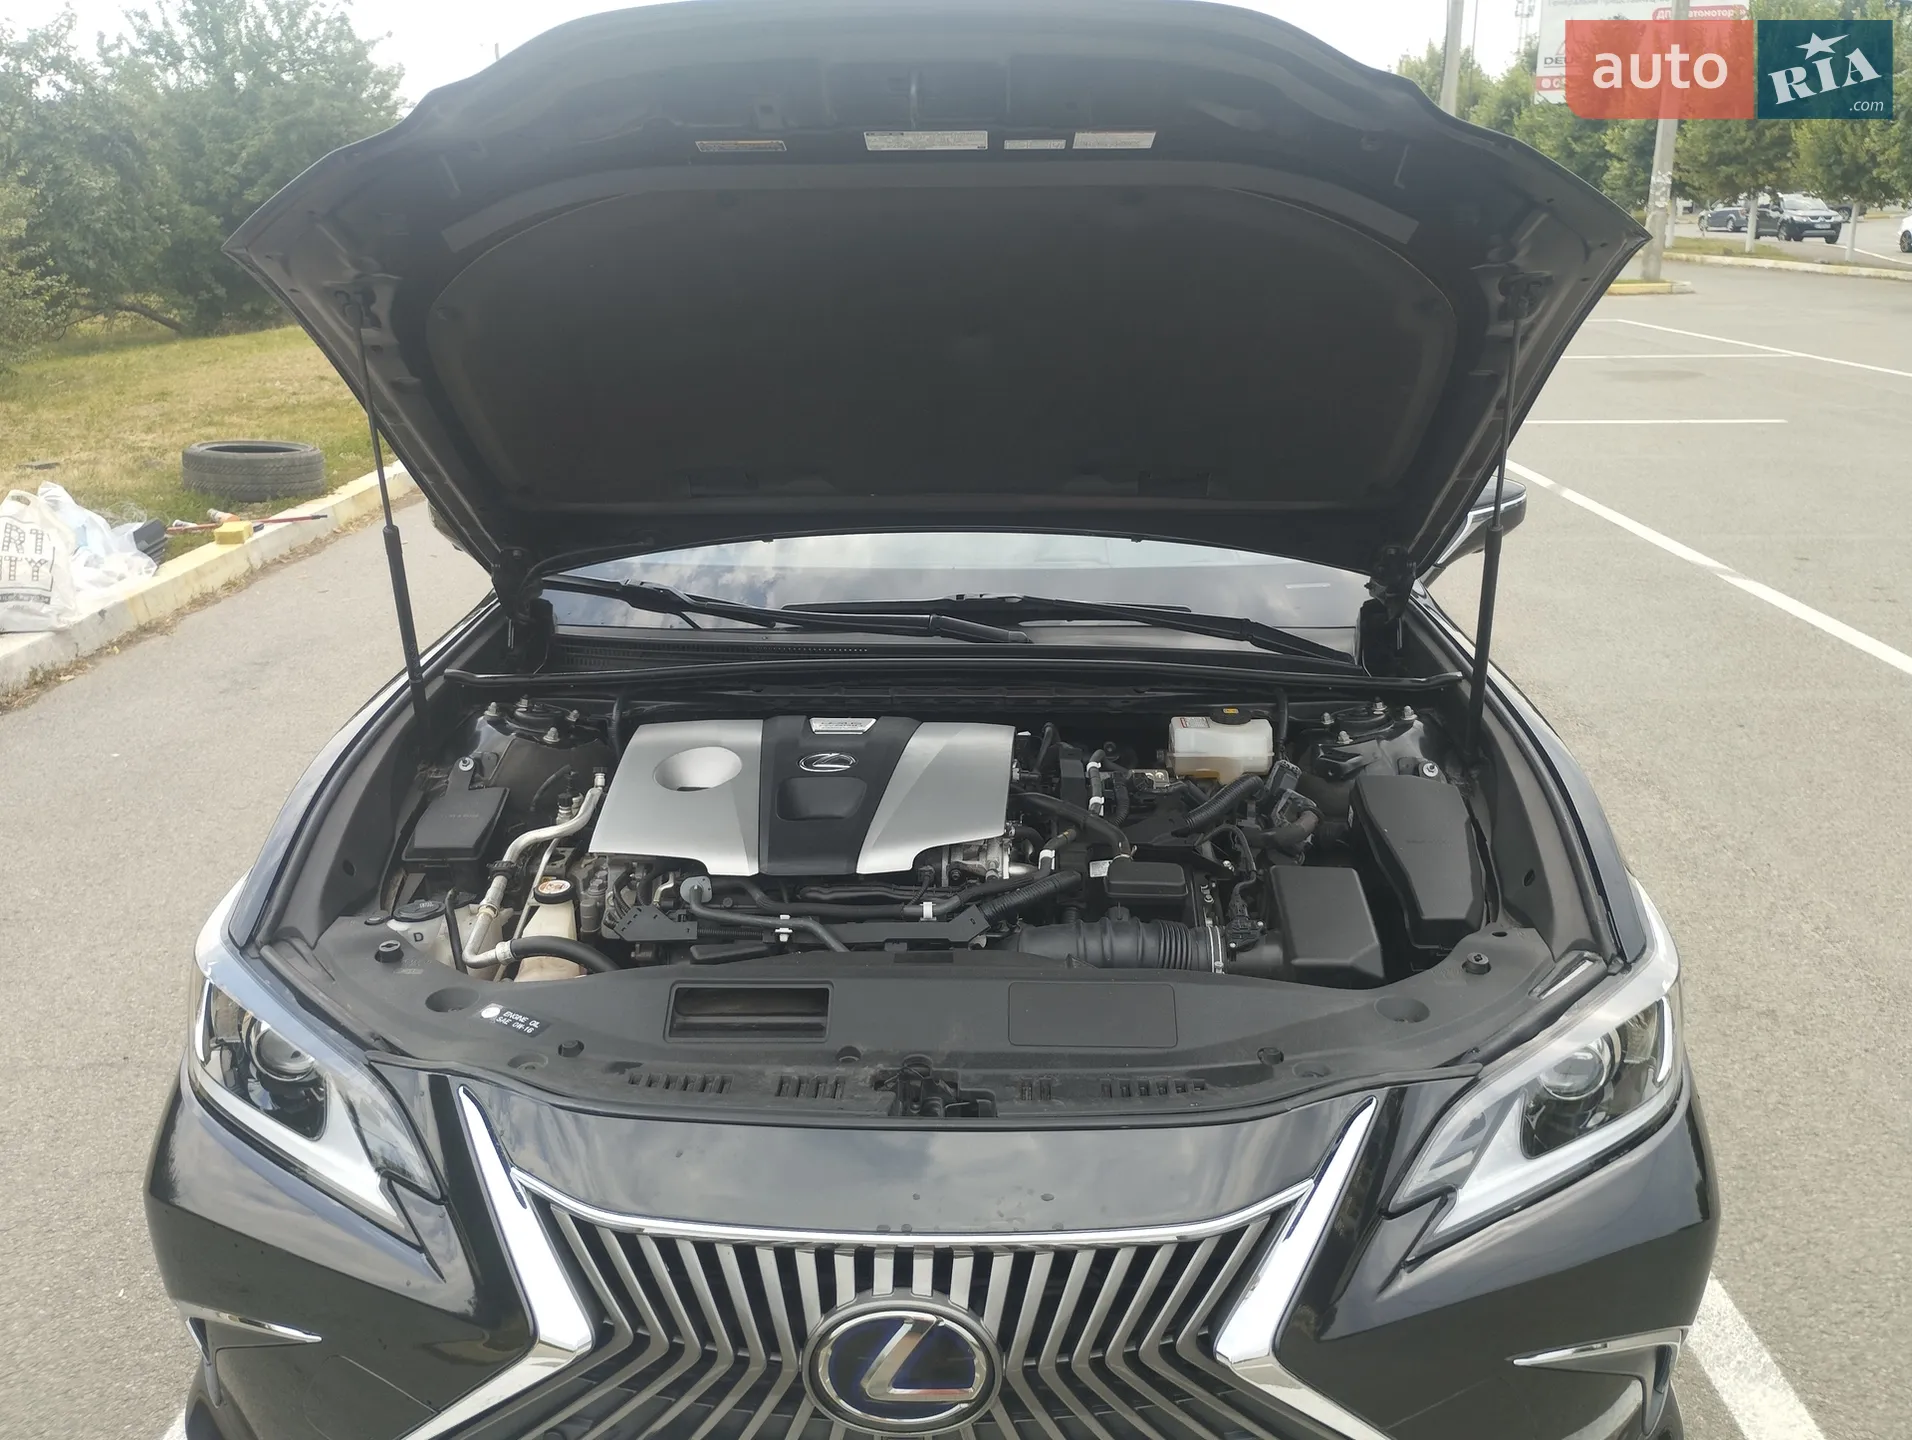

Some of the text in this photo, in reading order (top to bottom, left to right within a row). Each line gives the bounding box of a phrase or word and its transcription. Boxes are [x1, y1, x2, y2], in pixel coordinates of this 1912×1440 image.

[1, 522, 48, 555] RT
[495, 1016, 512, 1025] SAE
[503, 1010, 541, 1029] ENGINE OIL
